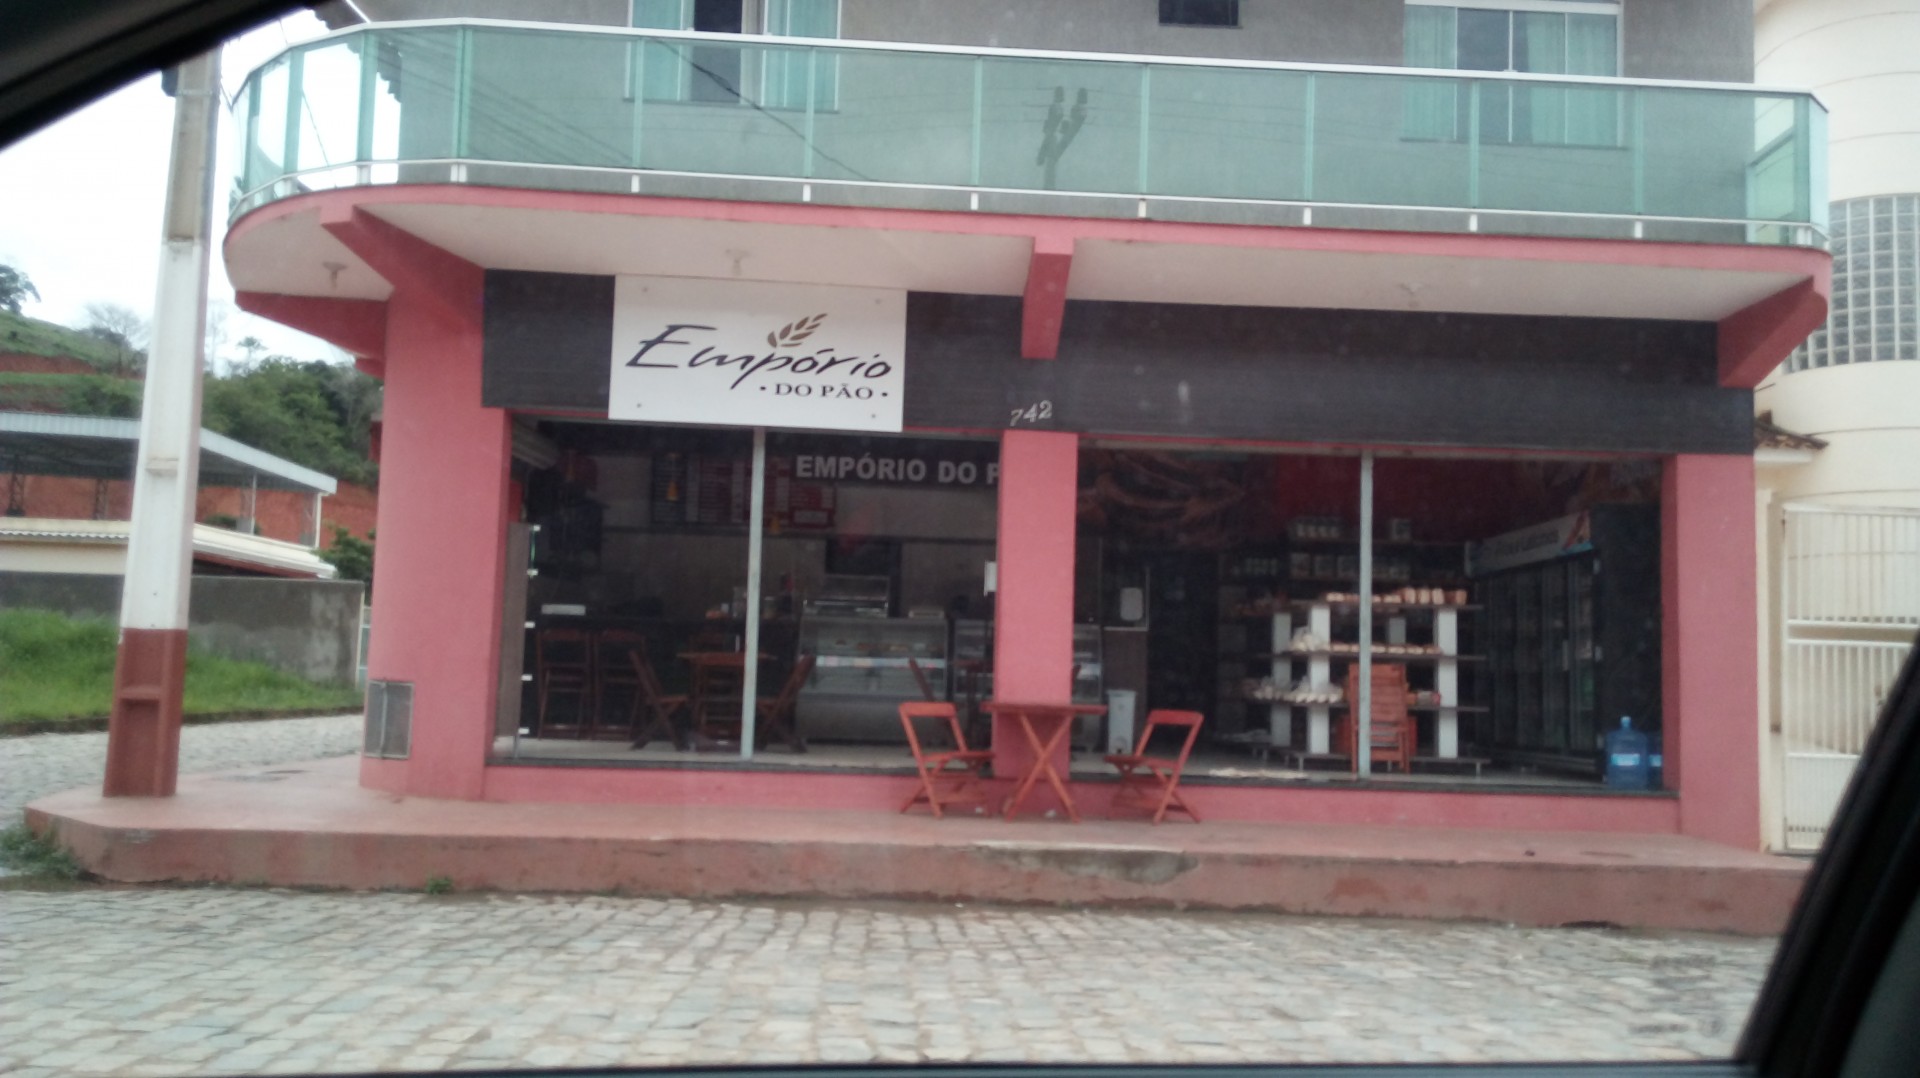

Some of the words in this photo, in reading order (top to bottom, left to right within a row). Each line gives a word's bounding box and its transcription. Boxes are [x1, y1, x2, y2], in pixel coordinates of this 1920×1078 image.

[625, 323, 893, 390] Empório
[774, 382, 813, 397] DO
[821, 382, 874, 400] PÃO
[1009, 399, 1053, 427] 742
[795, 452, 928, 482] EMPÓRIO
[937, 460, 978, 484] DO
